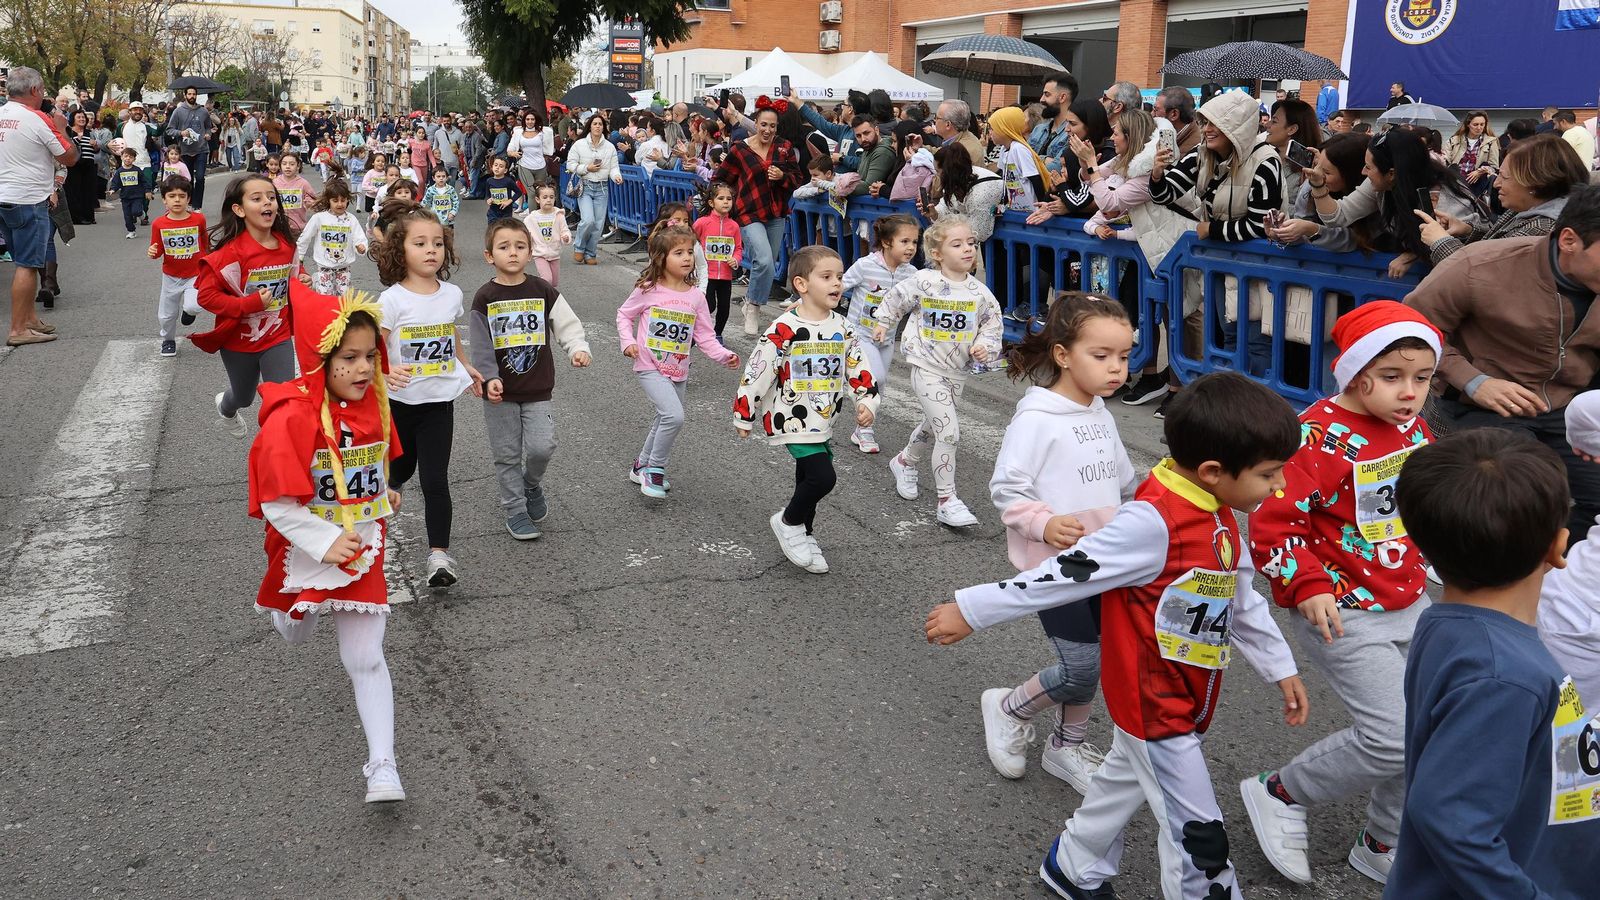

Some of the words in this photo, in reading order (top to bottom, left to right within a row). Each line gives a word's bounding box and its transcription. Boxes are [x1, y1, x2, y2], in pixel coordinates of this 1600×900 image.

[1391, 14, 1414, 40] CONSORCIO
[1439, 16, 1448, 26] DE
[714, 86, 744, 98] BOEROS
[168, 236, 194, 248] 639
[324, 232, 346, 243] 641
[712, 244, 731, 254] 019
[497, 314, 538, 334] 748
[929, 312, 967, 330] 158
[410, 331, 436, 339] BOMBEROS
[654, 322, 689, 342] 295
[410, 338, 454, 360] 724
[802, 358, 841, 376] 132
[342, 446, 366, 458] INFANTIL
[322, 458, 358, 469] BOEROS
[358, 458, 366, 466] DE
[1078, 461, 1117, 484] YOURSEL
[1361, 460, 1388, 474] CARRERA
[318, 468, 379, 502] 845
[1376, 484, 1396, 516] 3
[1192, 570, 1219, 584] ARRERA
[1186, 602, 1228, 639] 14
[1578, 723, 1600, 776] 6
